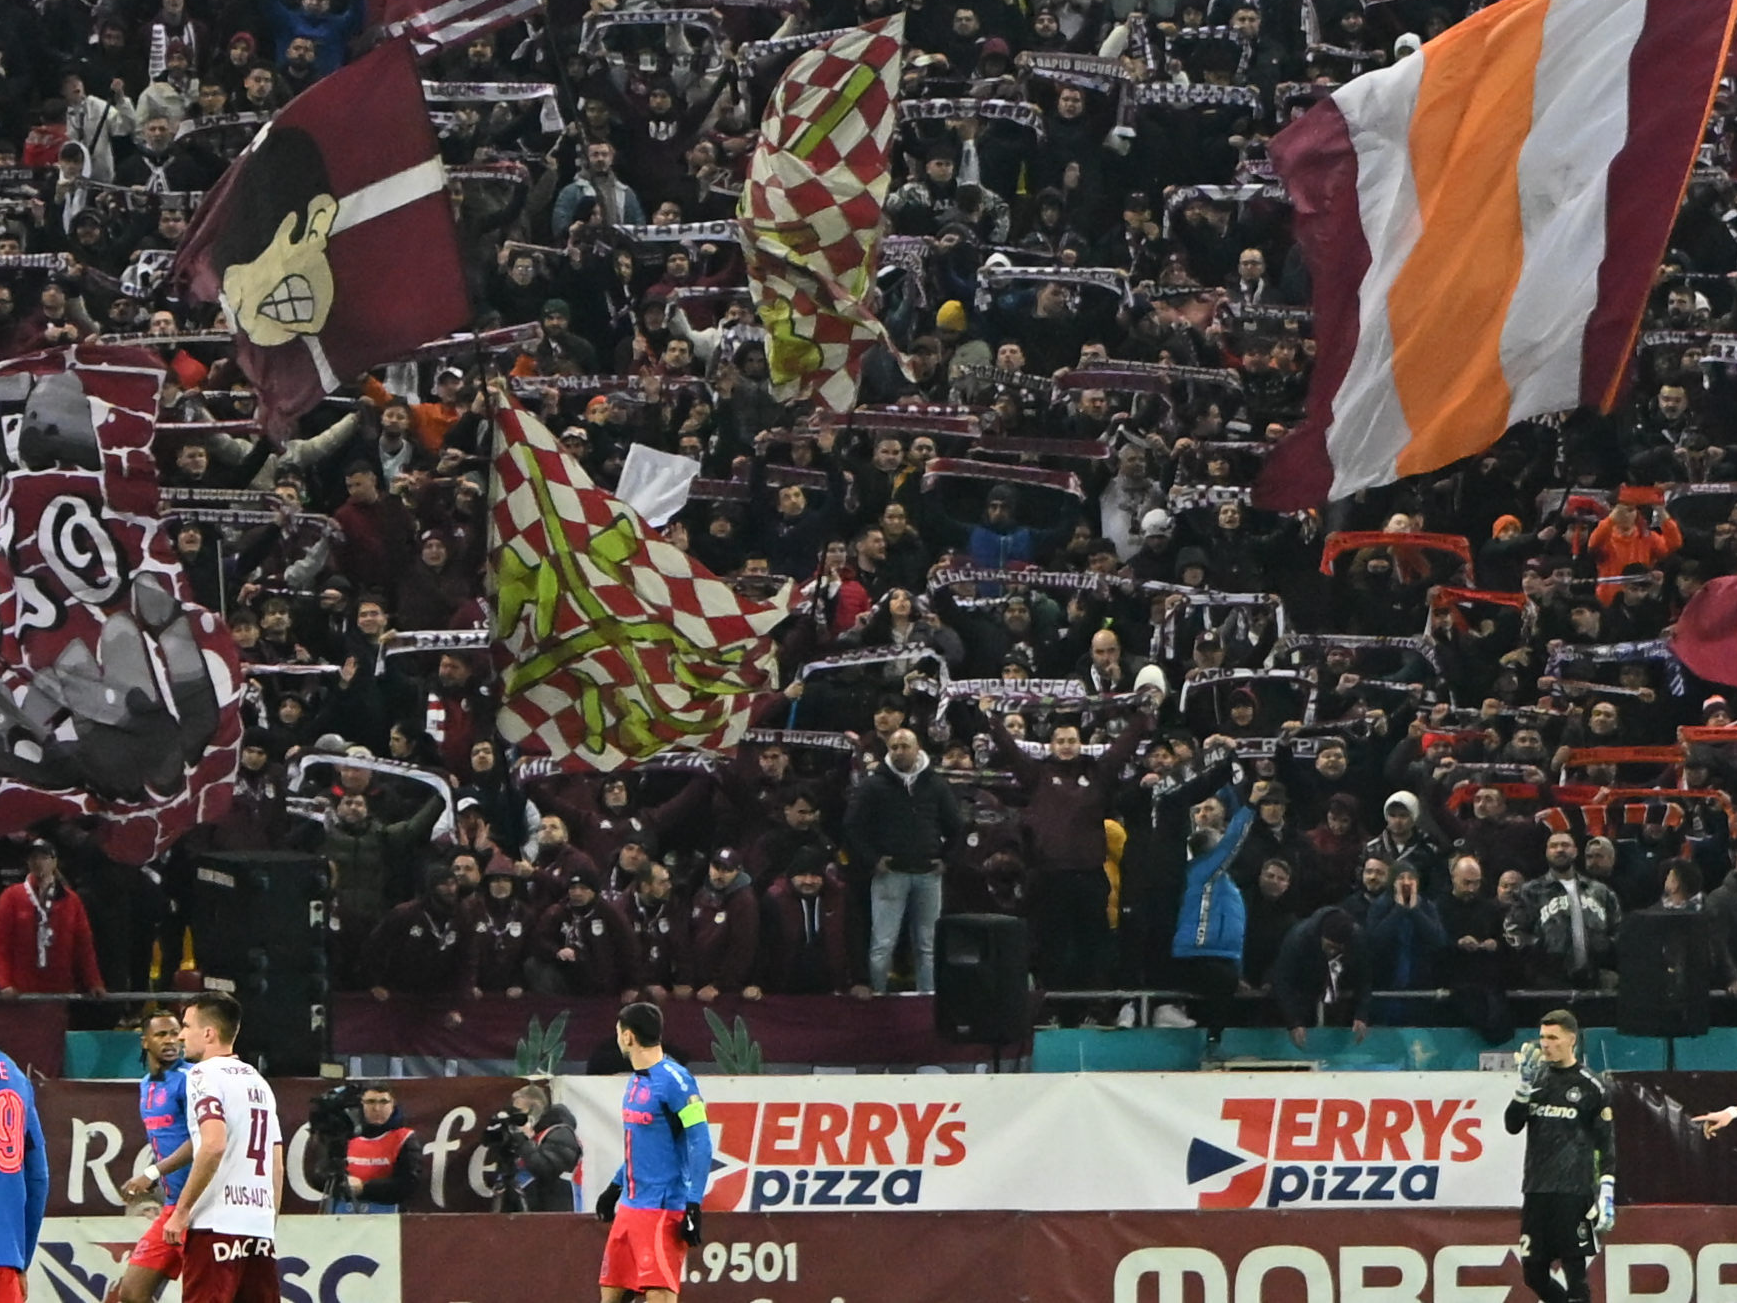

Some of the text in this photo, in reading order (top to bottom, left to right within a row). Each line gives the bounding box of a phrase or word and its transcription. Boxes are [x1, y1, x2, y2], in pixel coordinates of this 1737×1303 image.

[245, 1108, 270, 1177] 4
[750, 1166, 923, 1212] pizza
[1267, 1164, 1441, 1209] pizza
[212, 1239, 250, 1262] DAC
